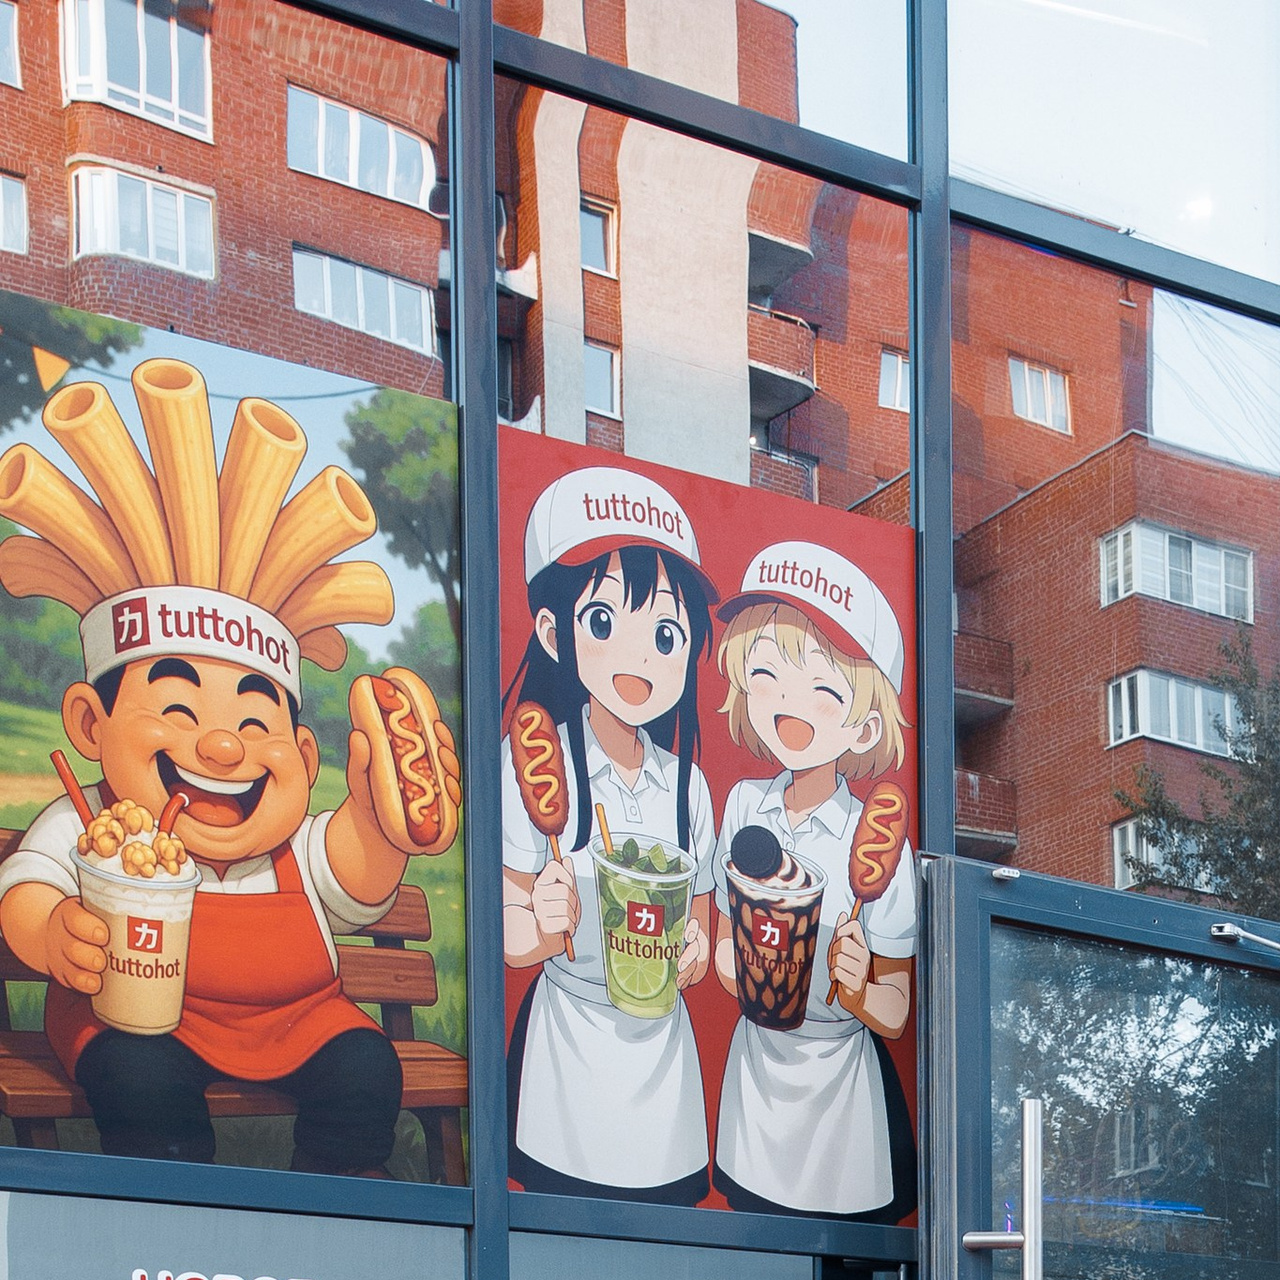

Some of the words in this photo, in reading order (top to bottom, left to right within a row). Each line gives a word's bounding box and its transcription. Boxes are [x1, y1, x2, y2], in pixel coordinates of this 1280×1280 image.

[582, 490, 686, 543] tuttohot
[756, 557, 856, 612] tuttohot
[157, 603, 293, 675] tuttohot
[108, 951, 182, 981] tuttohot
[608, 929, 681, 961] tuttohot
[740, 944, 807, 975] tuttohot
